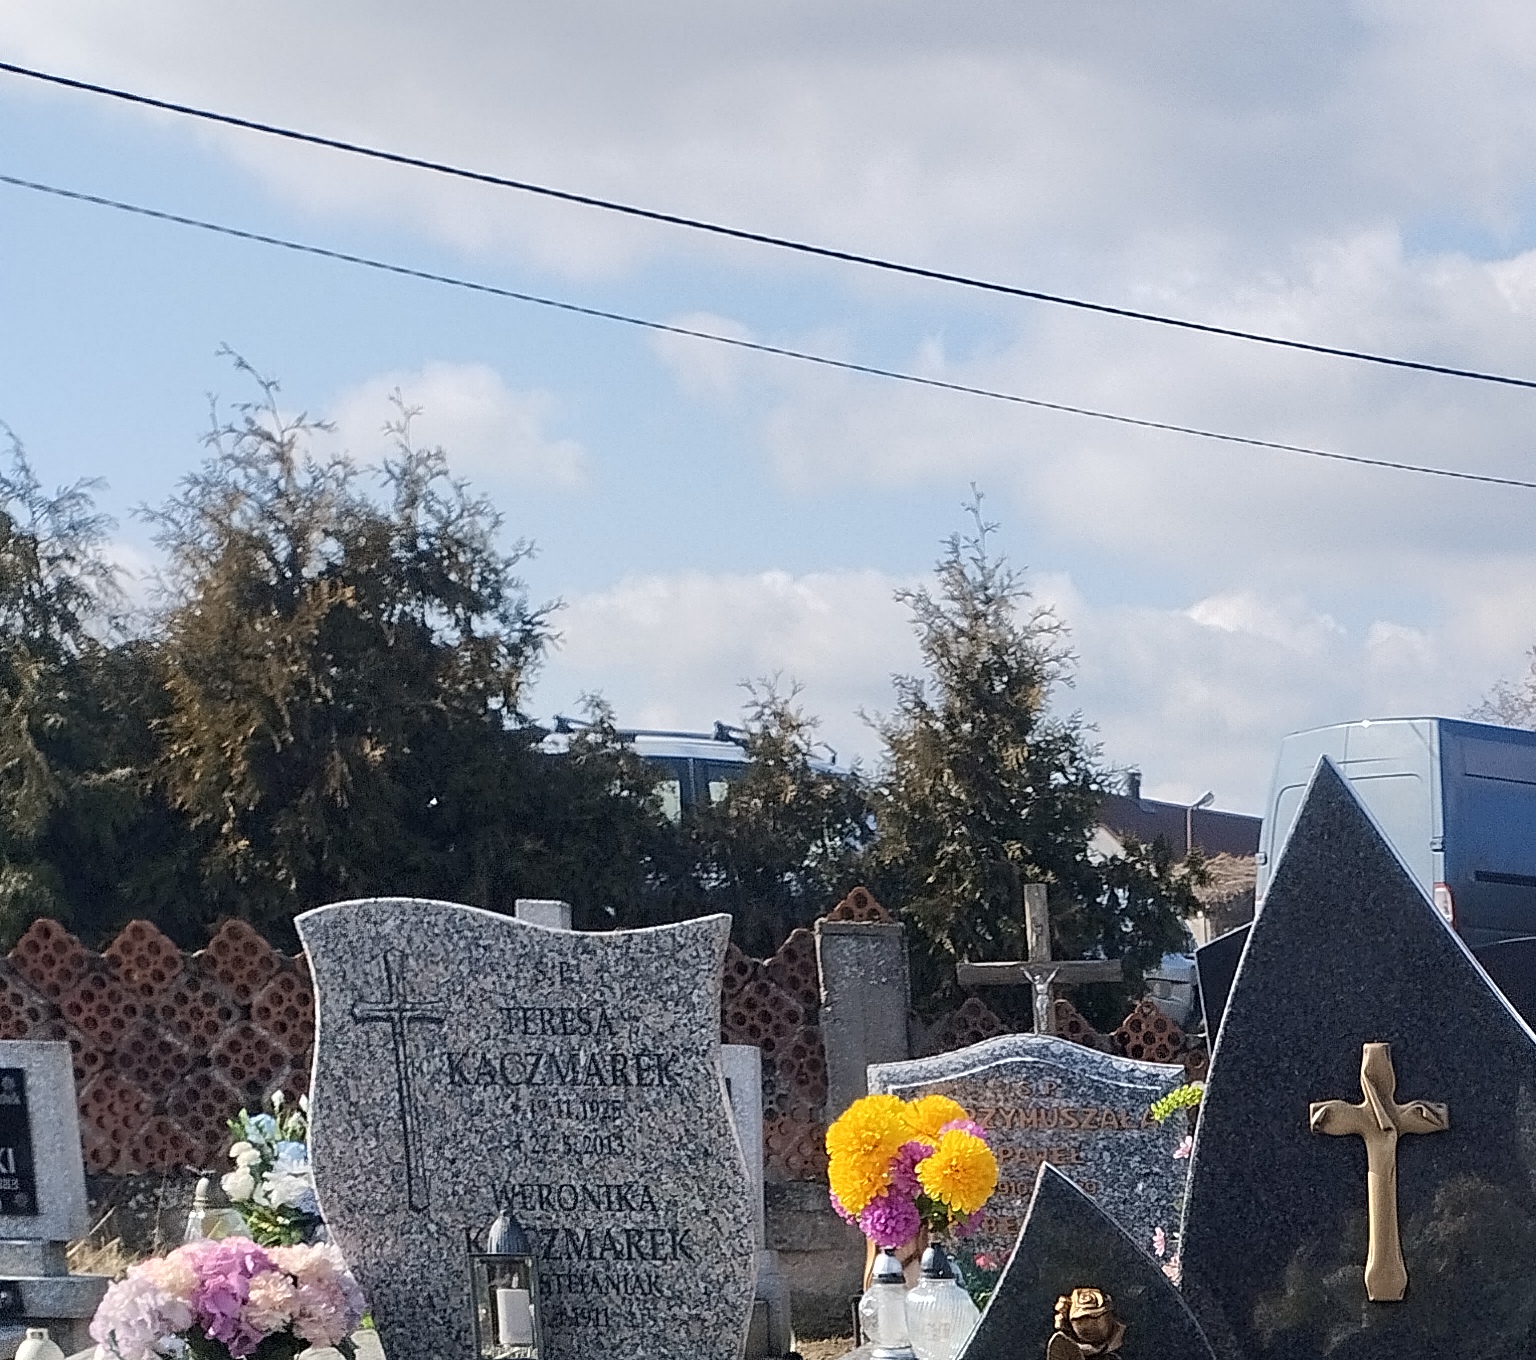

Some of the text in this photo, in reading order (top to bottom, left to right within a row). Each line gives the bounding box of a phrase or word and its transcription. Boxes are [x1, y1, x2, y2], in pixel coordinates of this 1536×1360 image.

[500, 1005, 617, 1037] TERESA
[449, 1051, 681, 1089] KACZMAREK
[492, 1183, 658, 1212] WERONIKA
[464, 1227, 697, 1262] KZMAREK
